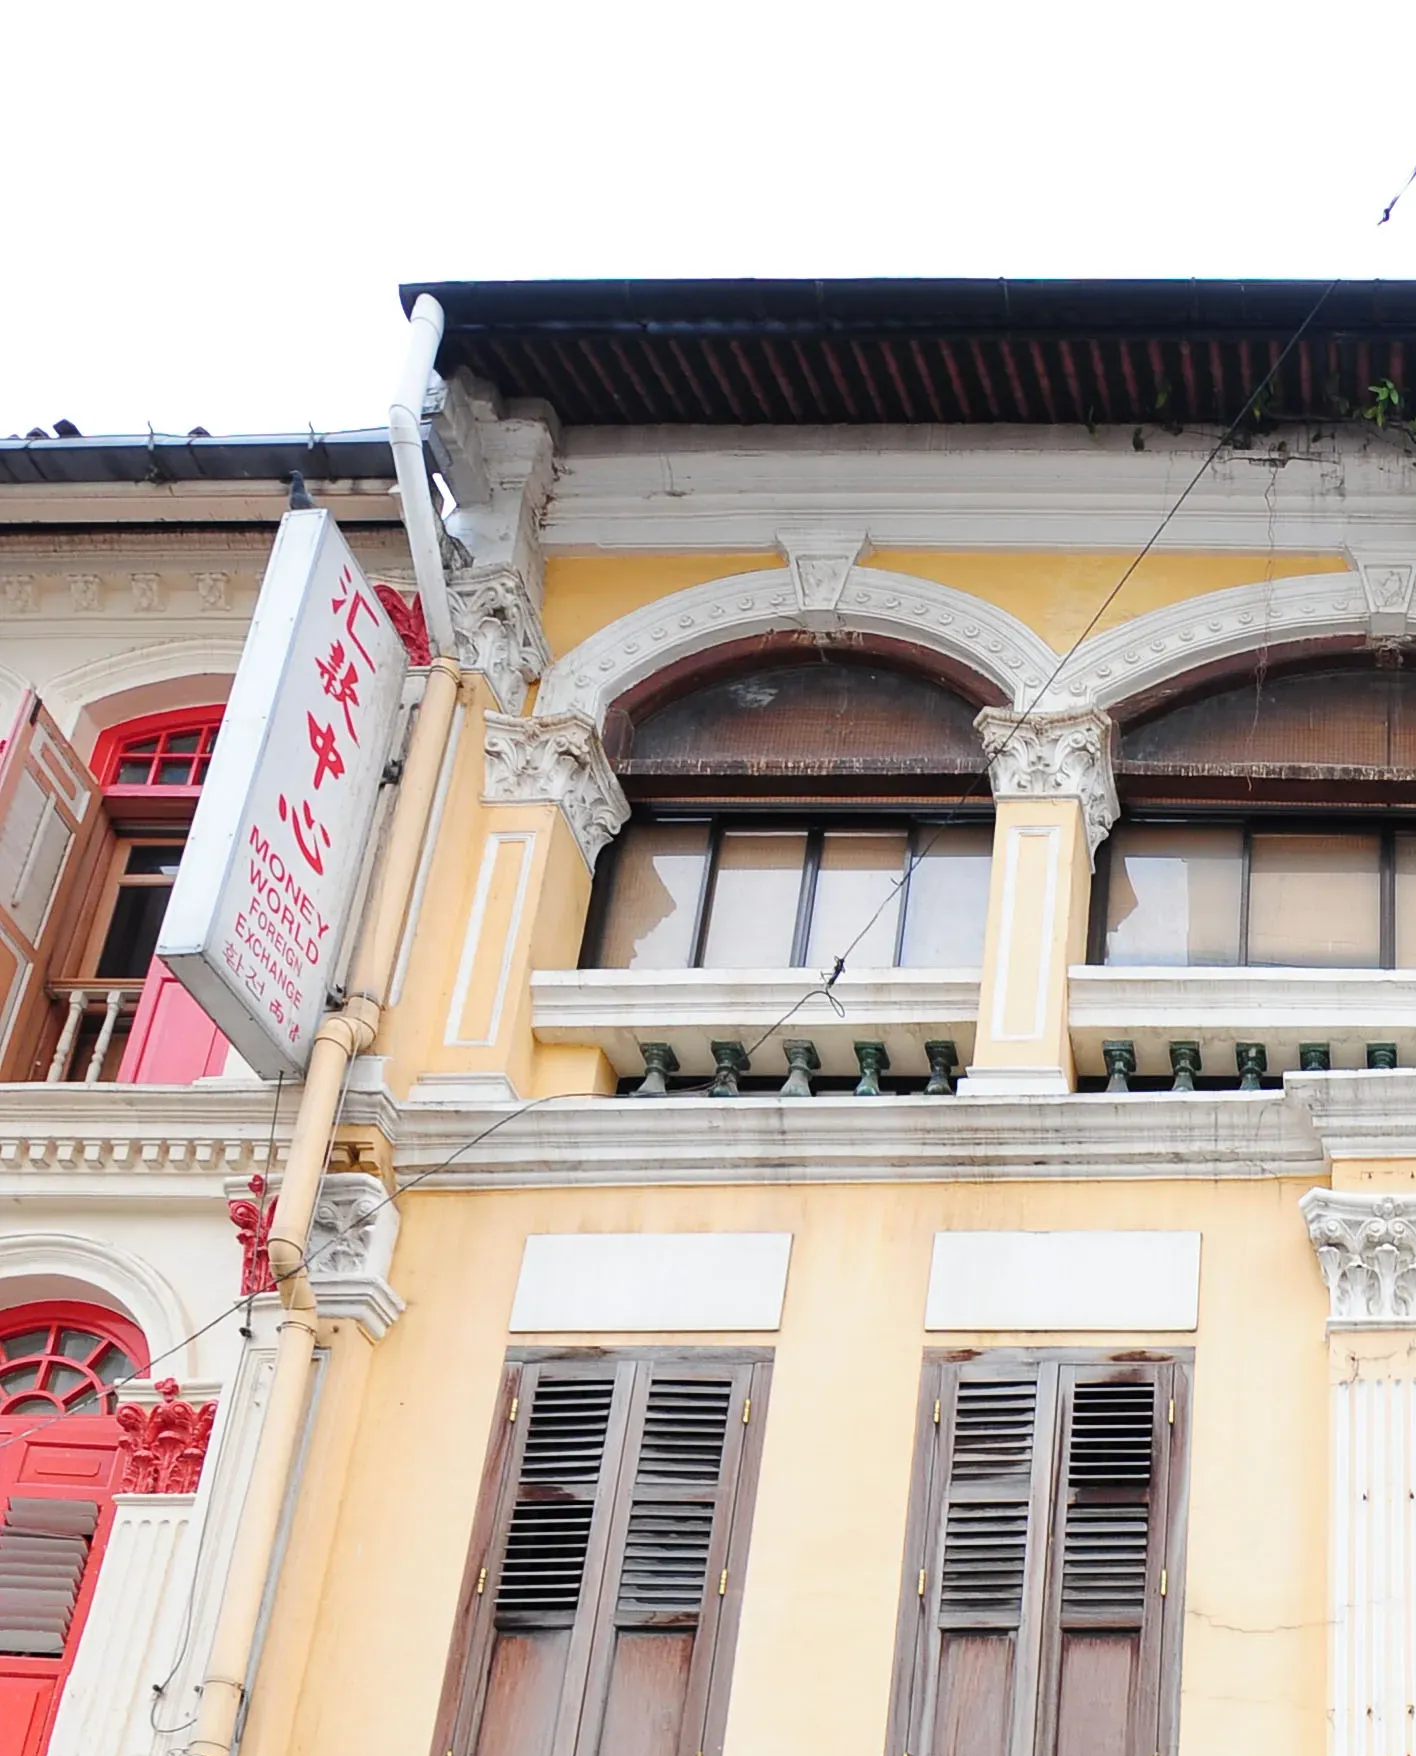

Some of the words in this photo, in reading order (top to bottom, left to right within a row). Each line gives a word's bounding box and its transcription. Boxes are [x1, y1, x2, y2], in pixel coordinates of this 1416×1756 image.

[249, 824, 329, 940] MONEY
[250, 858, 319, 965] WORLD
[234, 912, 303, 1010] EXCHANGE
[248, 895, 303, 978] FOREIGN
